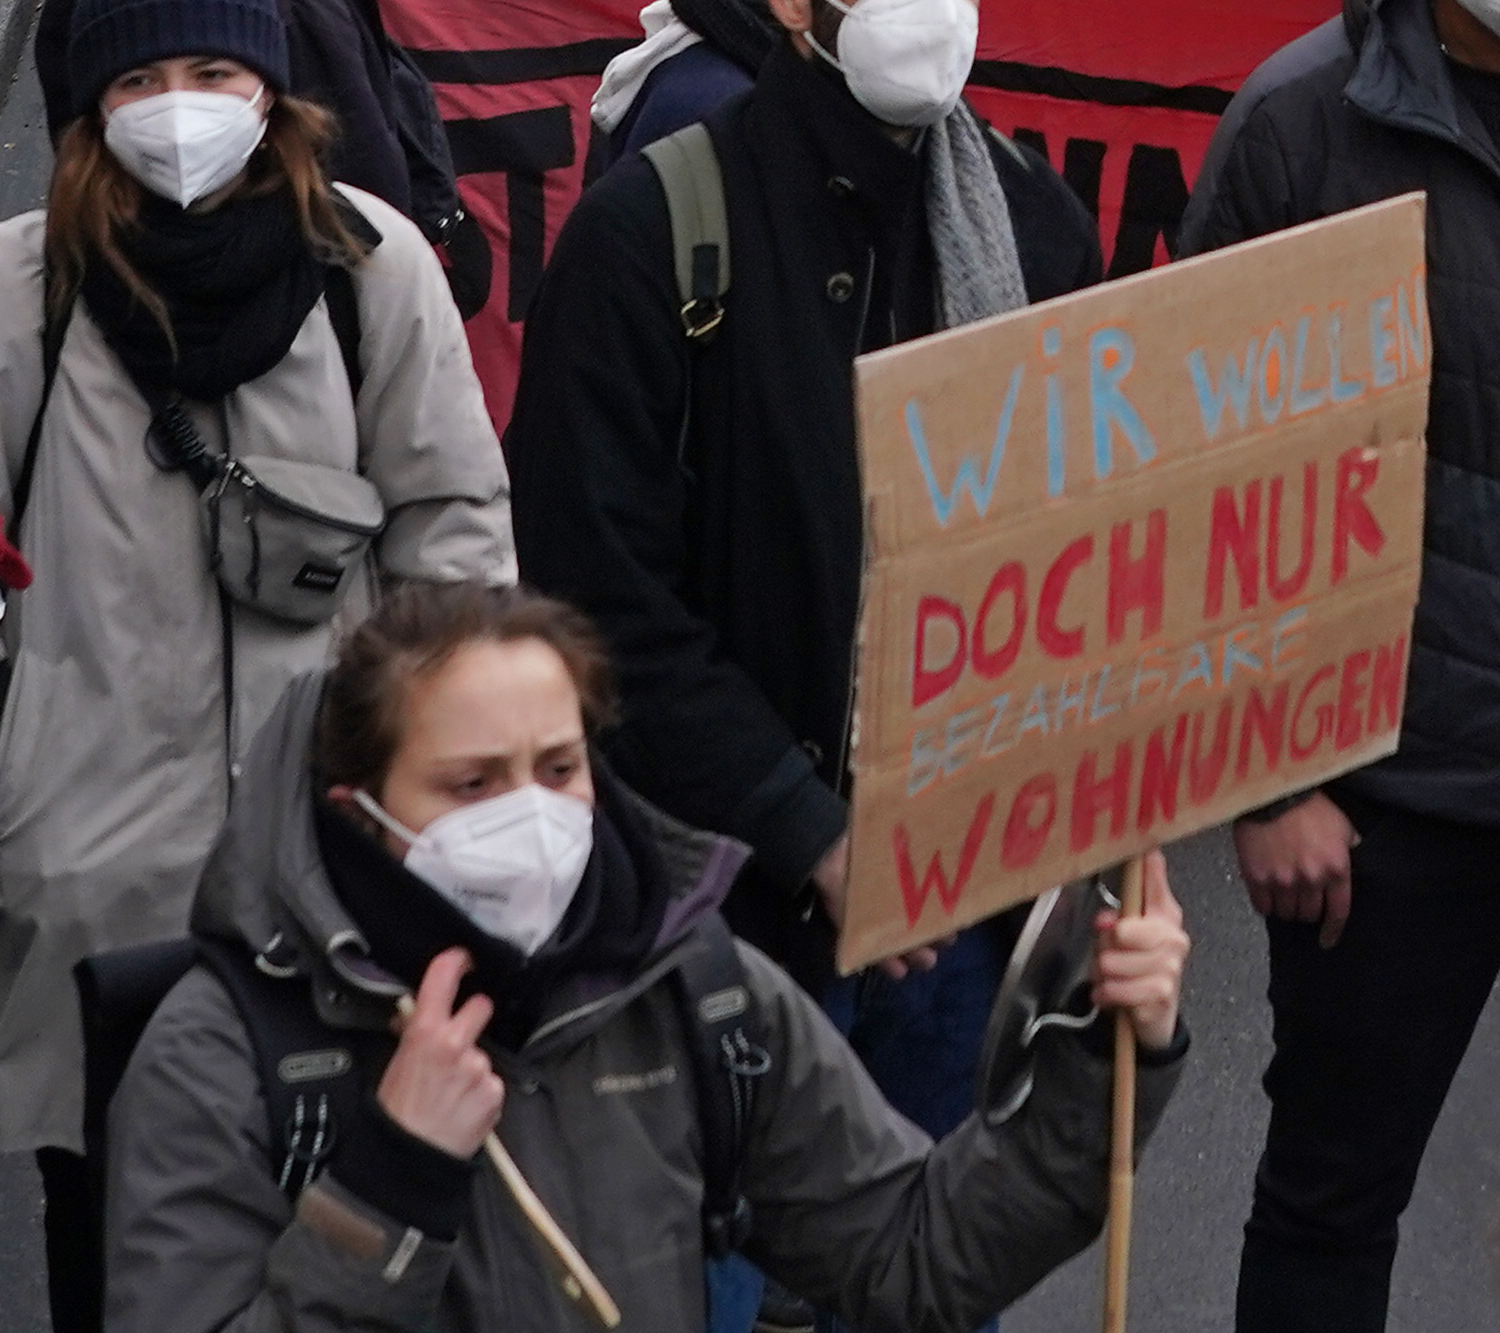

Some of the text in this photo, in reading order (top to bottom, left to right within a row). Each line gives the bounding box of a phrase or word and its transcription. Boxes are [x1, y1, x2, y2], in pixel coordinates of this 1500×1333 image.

[1187, 265, 1430, 443] WOLLEN
[912, 446, 1386, 710] DOCH NUR
[893, 634, 1408, 930] WOHNUNGEN
[906, 605, 1310, 798] BEZAHLBARE
